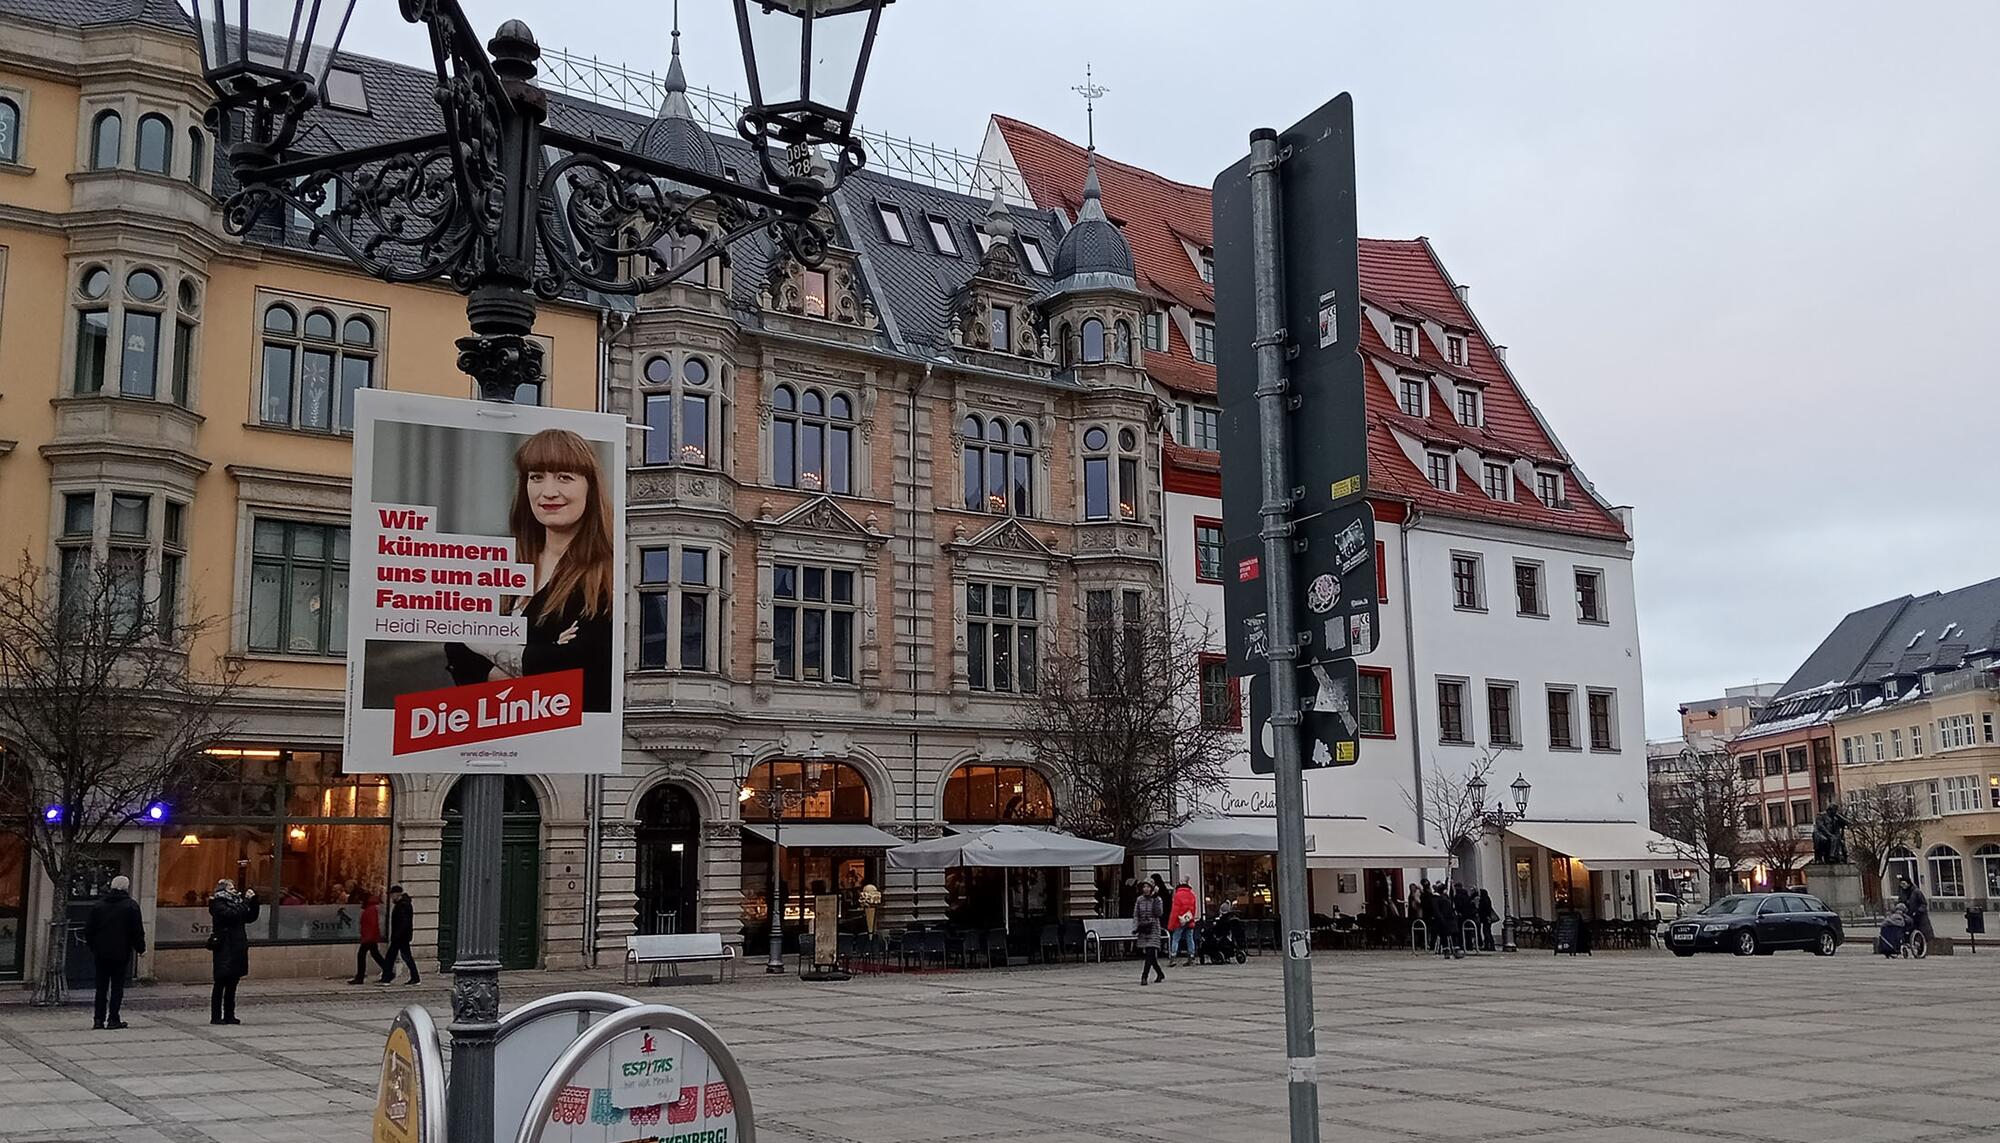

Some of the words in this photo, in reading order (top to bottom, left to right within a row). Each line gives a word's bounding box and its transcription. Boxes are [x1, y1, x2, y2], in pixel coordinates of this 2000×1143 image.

[378, 509, 429, 531] Wir
[378, 534, 508, 562] kümmern
[377, 566, 426, 583] uns
[431, 569, 473, 586] um
[477, 567, 527, 589] alle
[376, 589, 493, 613] Familien
[375, 617, 420, 634] Heidi
[425, 619, 520, 637] Reichinnek
[410, 702, 471, 739] Die
[477, 686, 571, 729] Linke
[1221, 790, 1249, 812] Gran
[622, 1058, 674, 1076] ESPITAS
